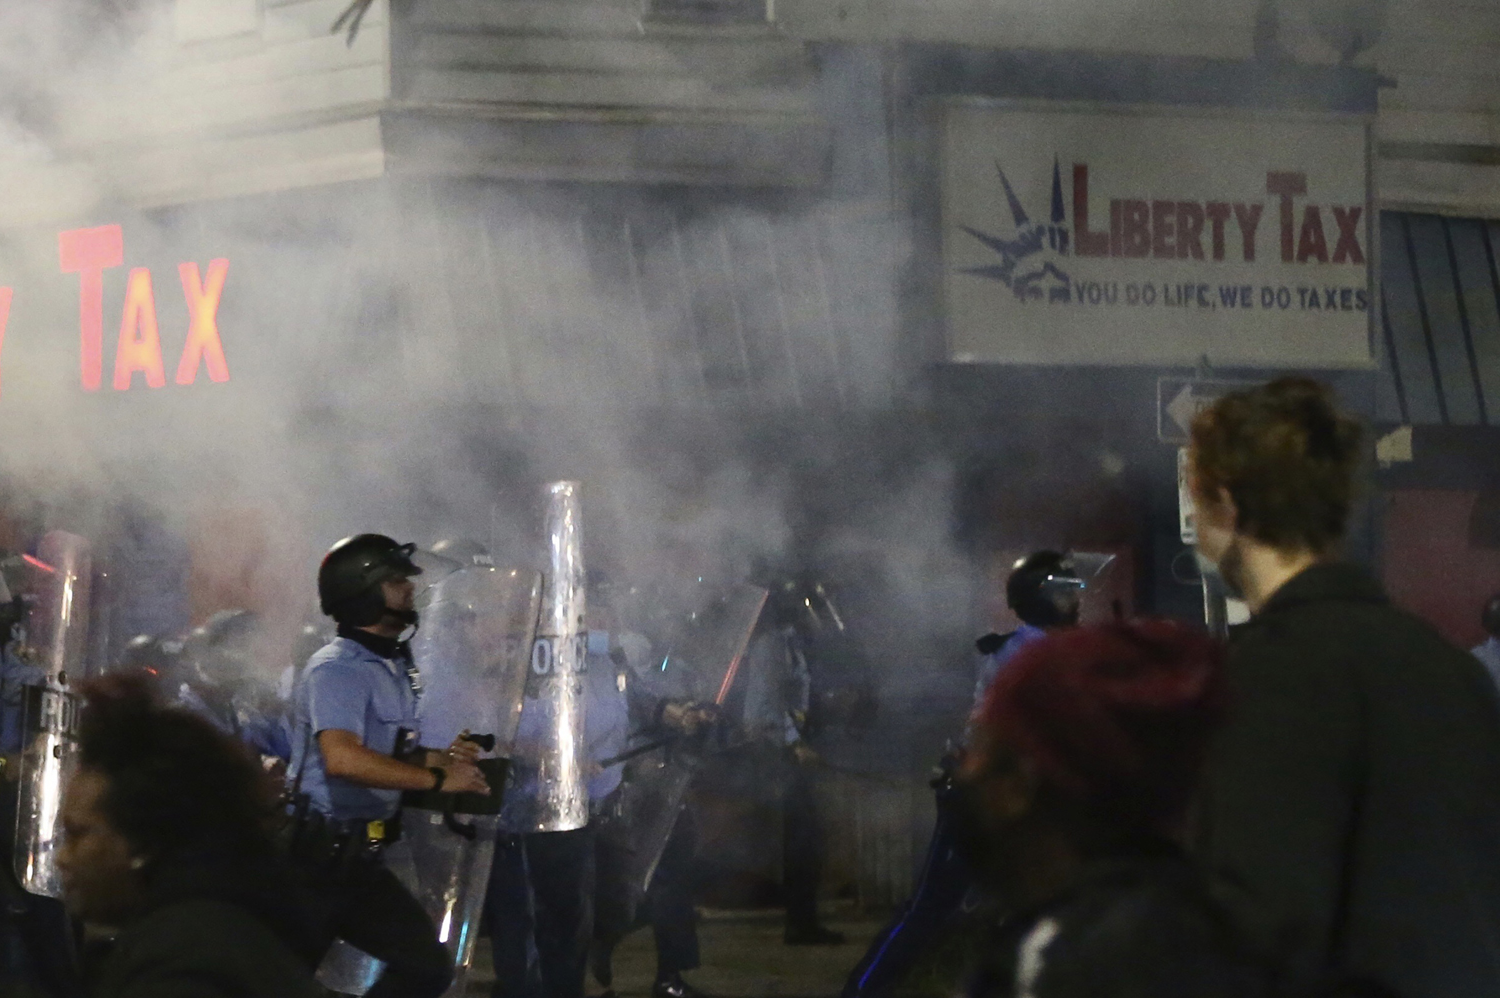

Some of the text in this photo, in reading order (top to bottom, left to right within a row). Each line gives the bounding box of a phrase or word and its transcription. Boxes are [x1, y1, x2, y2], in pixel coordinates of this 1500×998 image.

[1072, 163, 1367, 266] LIBERTY TAX
[58, 223, 230, 392] TAX
[1075, 282, 1119, 306] YOU
[1125, 283, 1157, 307] DO
[1260, 287, 1291, 310] DO
[1296, 288, 1369, 312] TAXES
